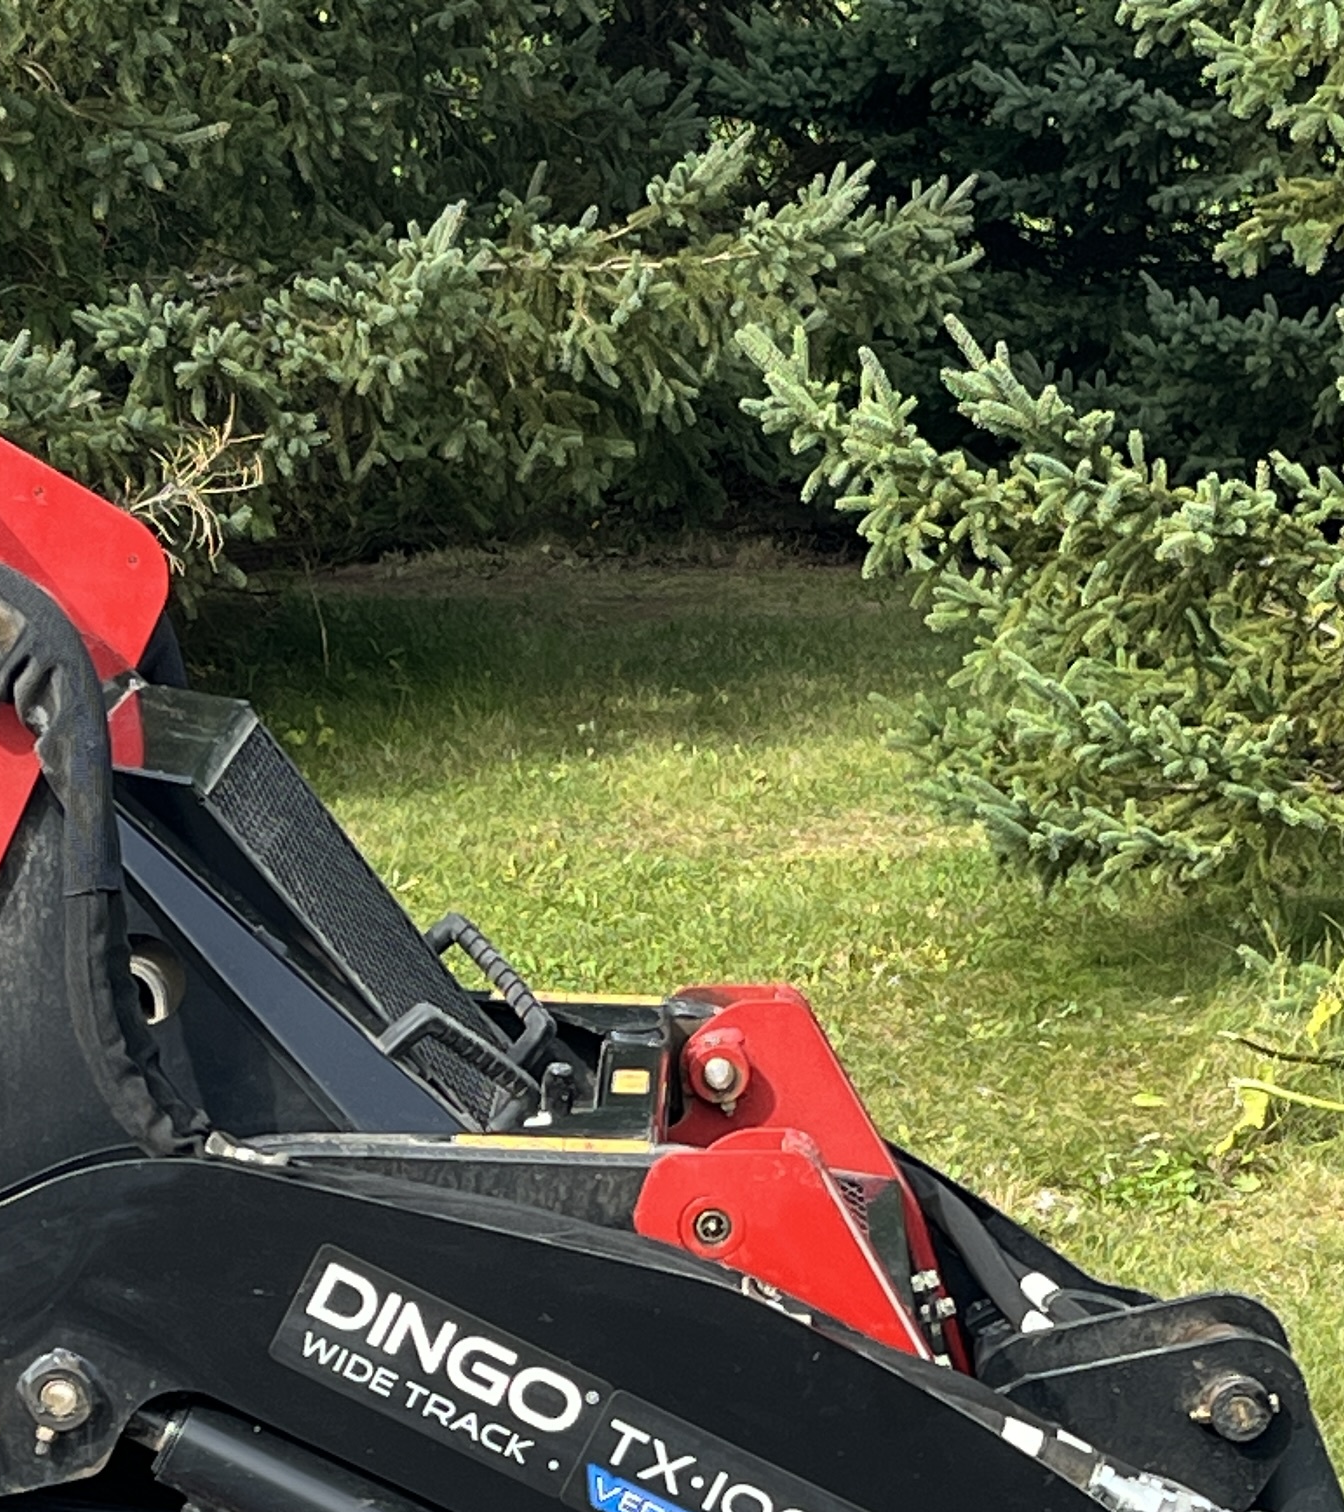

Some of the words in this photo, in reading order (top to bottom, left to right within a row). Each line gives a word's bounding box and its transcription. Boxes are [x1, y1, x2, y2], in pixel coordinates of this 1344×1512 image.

[301, 1331, 400, 1397] WIDE
[404, 1380, 536, 1465] TRACK
[306, 1262, 583, 1432] DINGO
